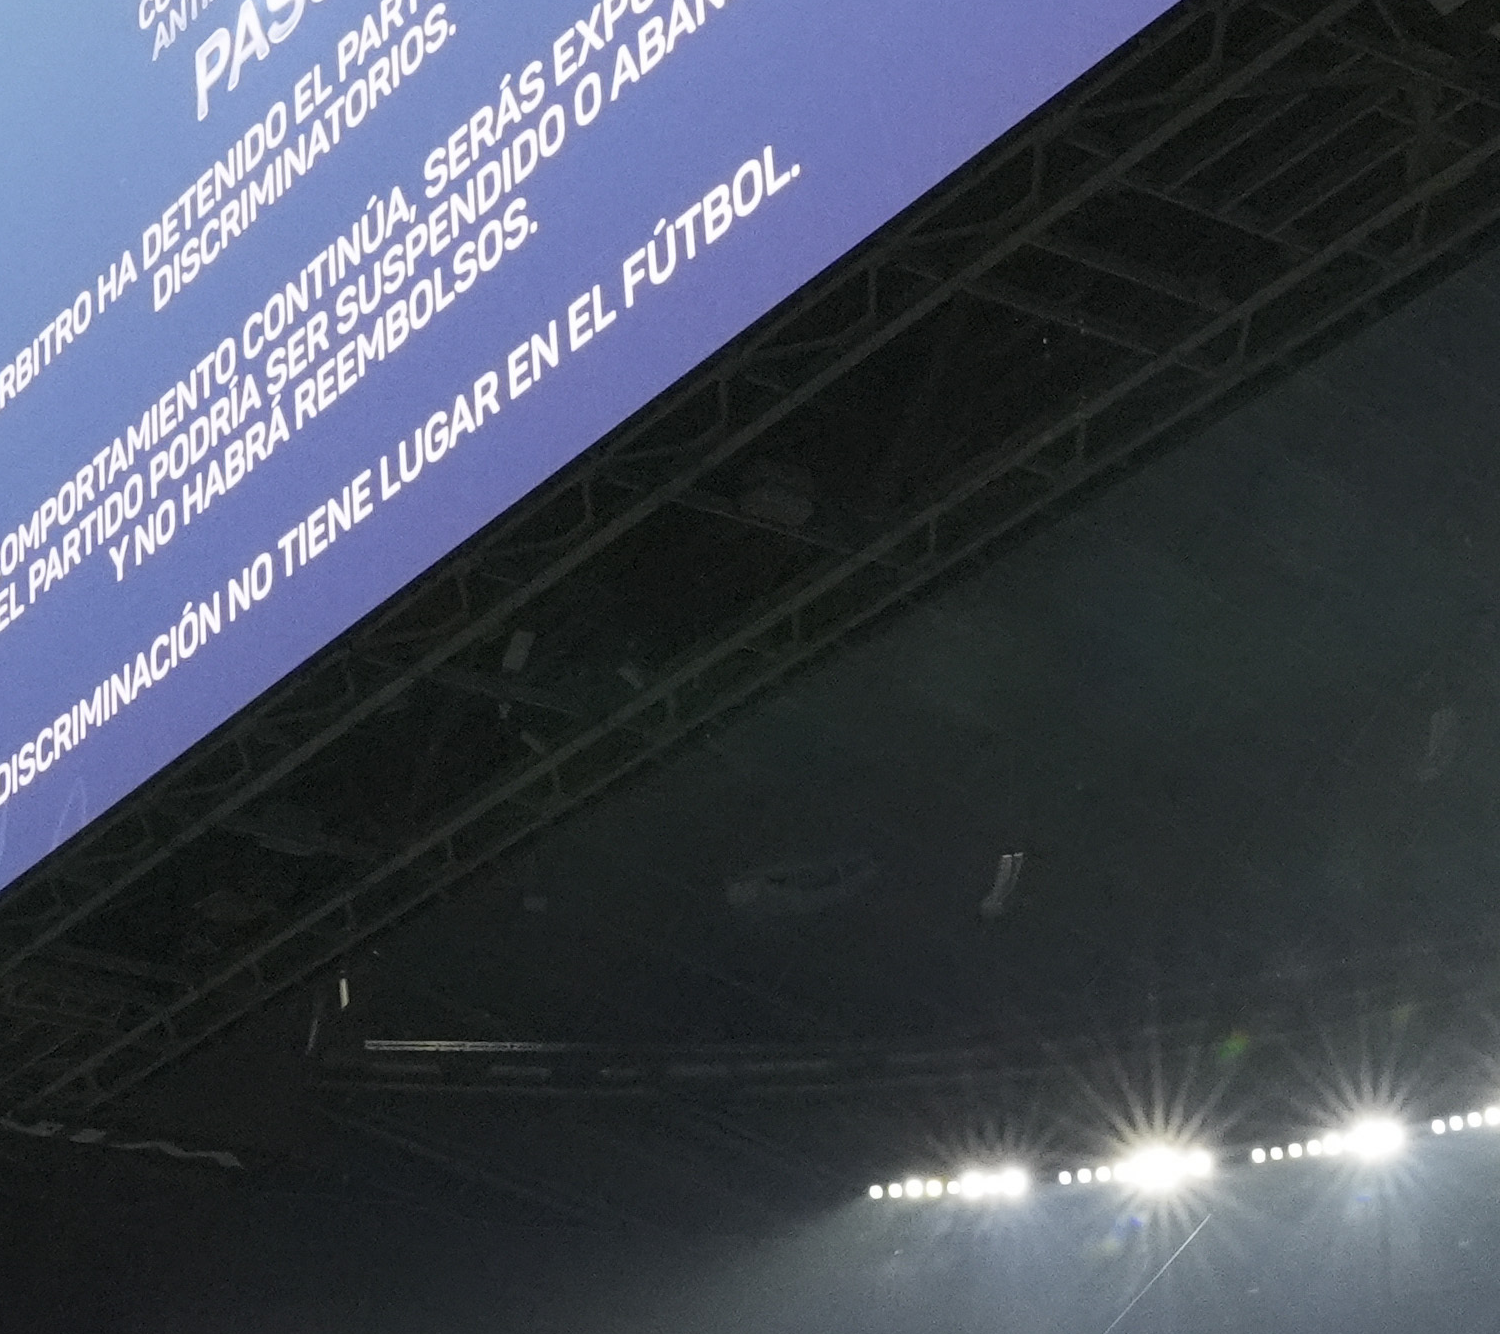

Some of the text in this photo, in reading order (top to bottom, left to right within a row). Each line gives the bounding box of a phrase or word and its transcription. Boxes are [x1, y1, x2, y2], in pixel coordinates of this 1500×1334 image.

[97, 250, 138, 314] HA
[142, 101, 287, 271] DETENIDO
[294, 64, 333, 125] EL
[153, 2, 457, 313] DISCRIMINATORIOS.
[242, 185, 417, 360] CONTINÚA,
[423, 60, 545, 199] SERÁS
[28, 473, 144, 604] PARTIDO
[149, 373, 262, 500] PODRÍA
[266, 310, 330, 396] SER
[335, 104, 566, 335] SUSPENDIDO
[574, 71, 602, 127] O
[108, 197, 538, 582] Y NO HABRÁ REEMBOLSOS.
[227, 552, 273, 622] NO
[277, 468, 374, 577] TIENE
[379, 370, 501, 501] LUGAR
[507, 319, 559, 400] EN
[567, 284, 617, 352] EL
[622, 145, 801, 309] FÚTBOL.
